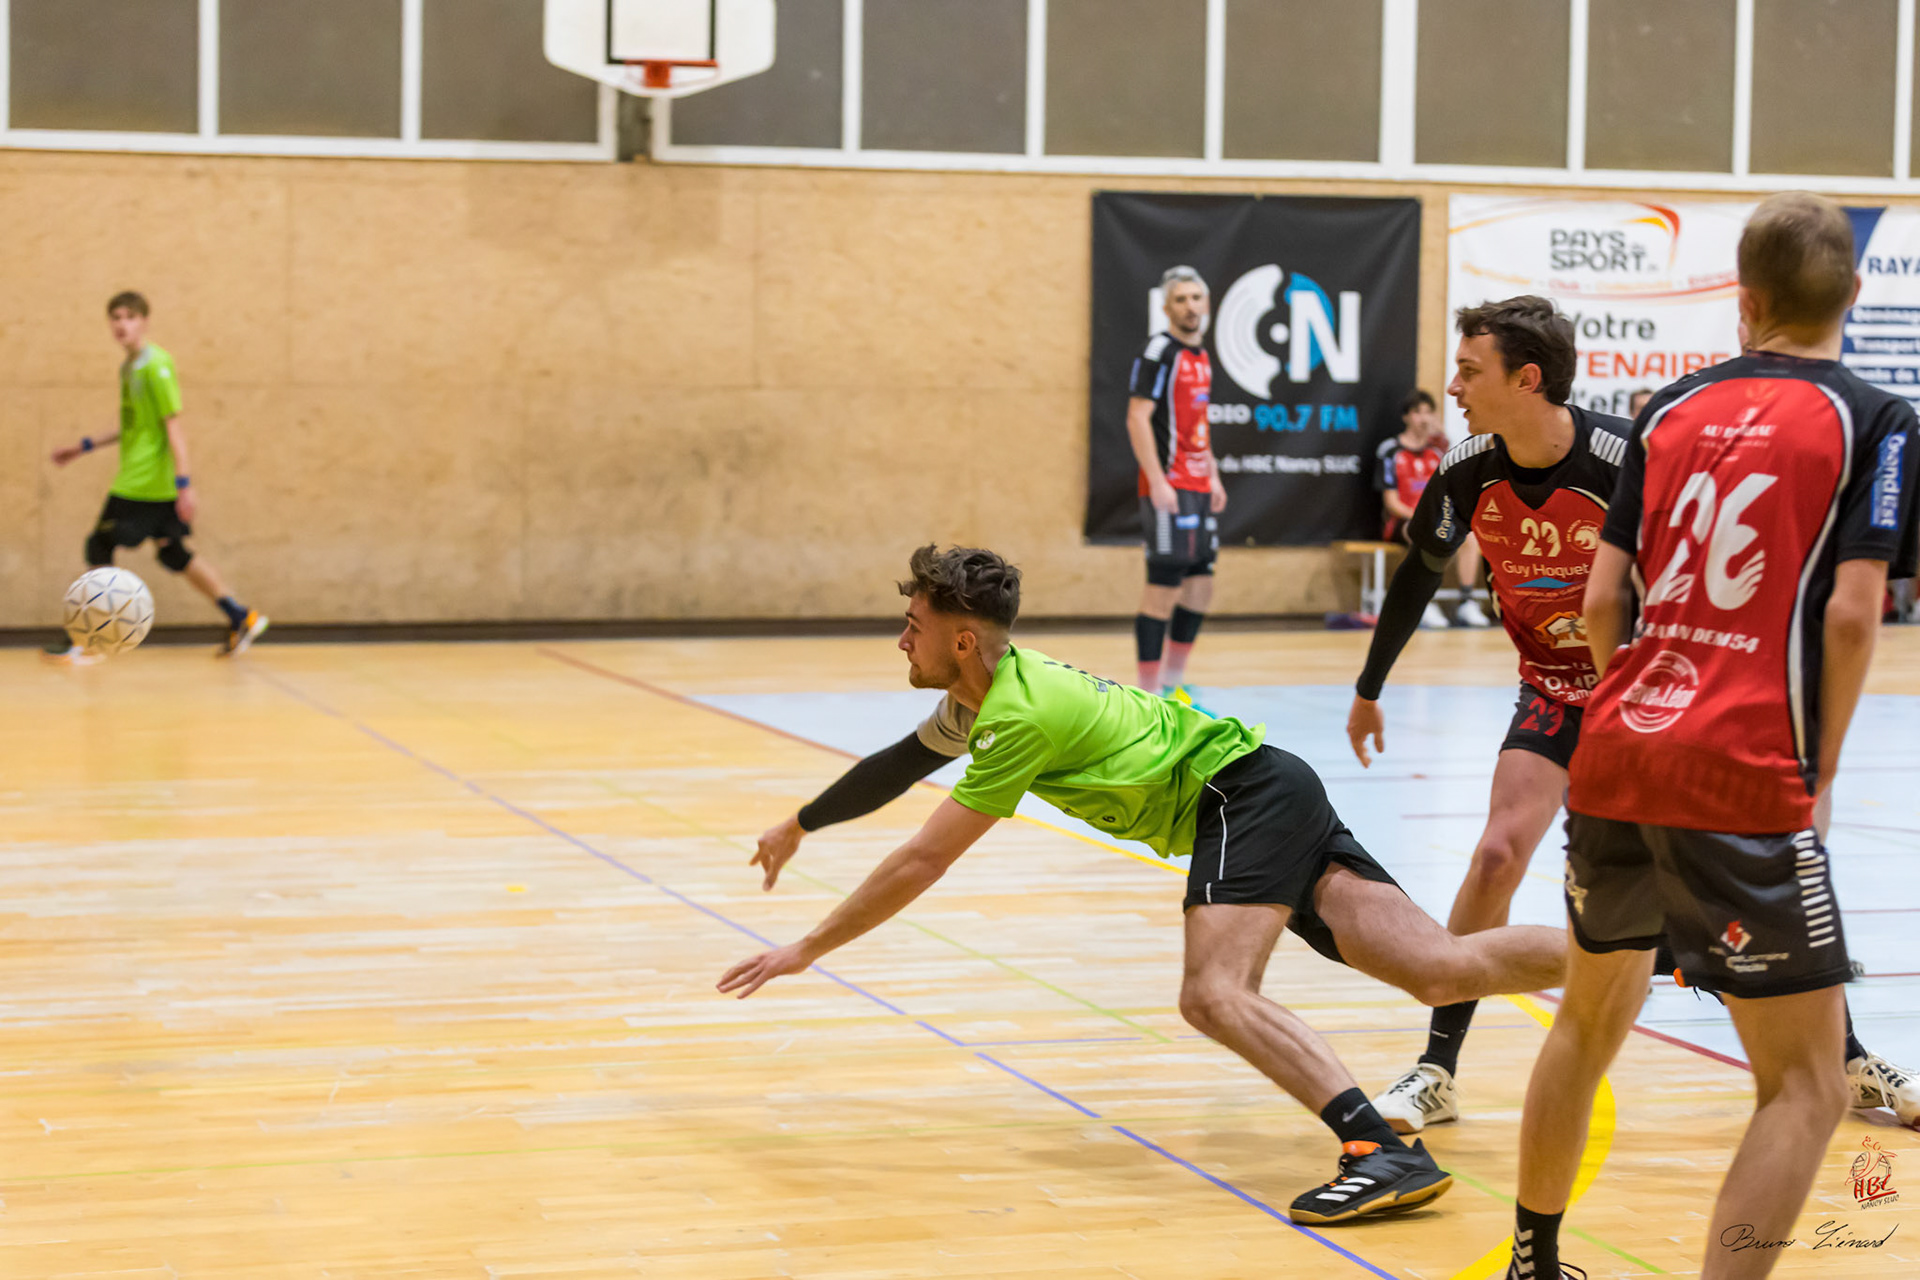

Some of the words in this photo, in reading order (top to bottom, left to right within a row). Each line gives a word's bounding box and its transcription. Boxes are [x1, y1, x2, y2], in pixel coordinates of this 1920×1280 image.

[1550, 229, 1626, 248] PAYS
[1550, 249, 1646, 271] SPORT
[1207, 403, 1251, 424] DIO
[1254, 403, 1313, 431] 90.7
[1320, 404, 1359, 431] FM
[1275, 455, 1321, 476] Nancy
[1521, 517, 1562, 558] 29
[1645, 471, 1779, 610] 26
[1502, 560, 1530, 577] Guy
[1533, 564, 1591, 579] Hoquet
